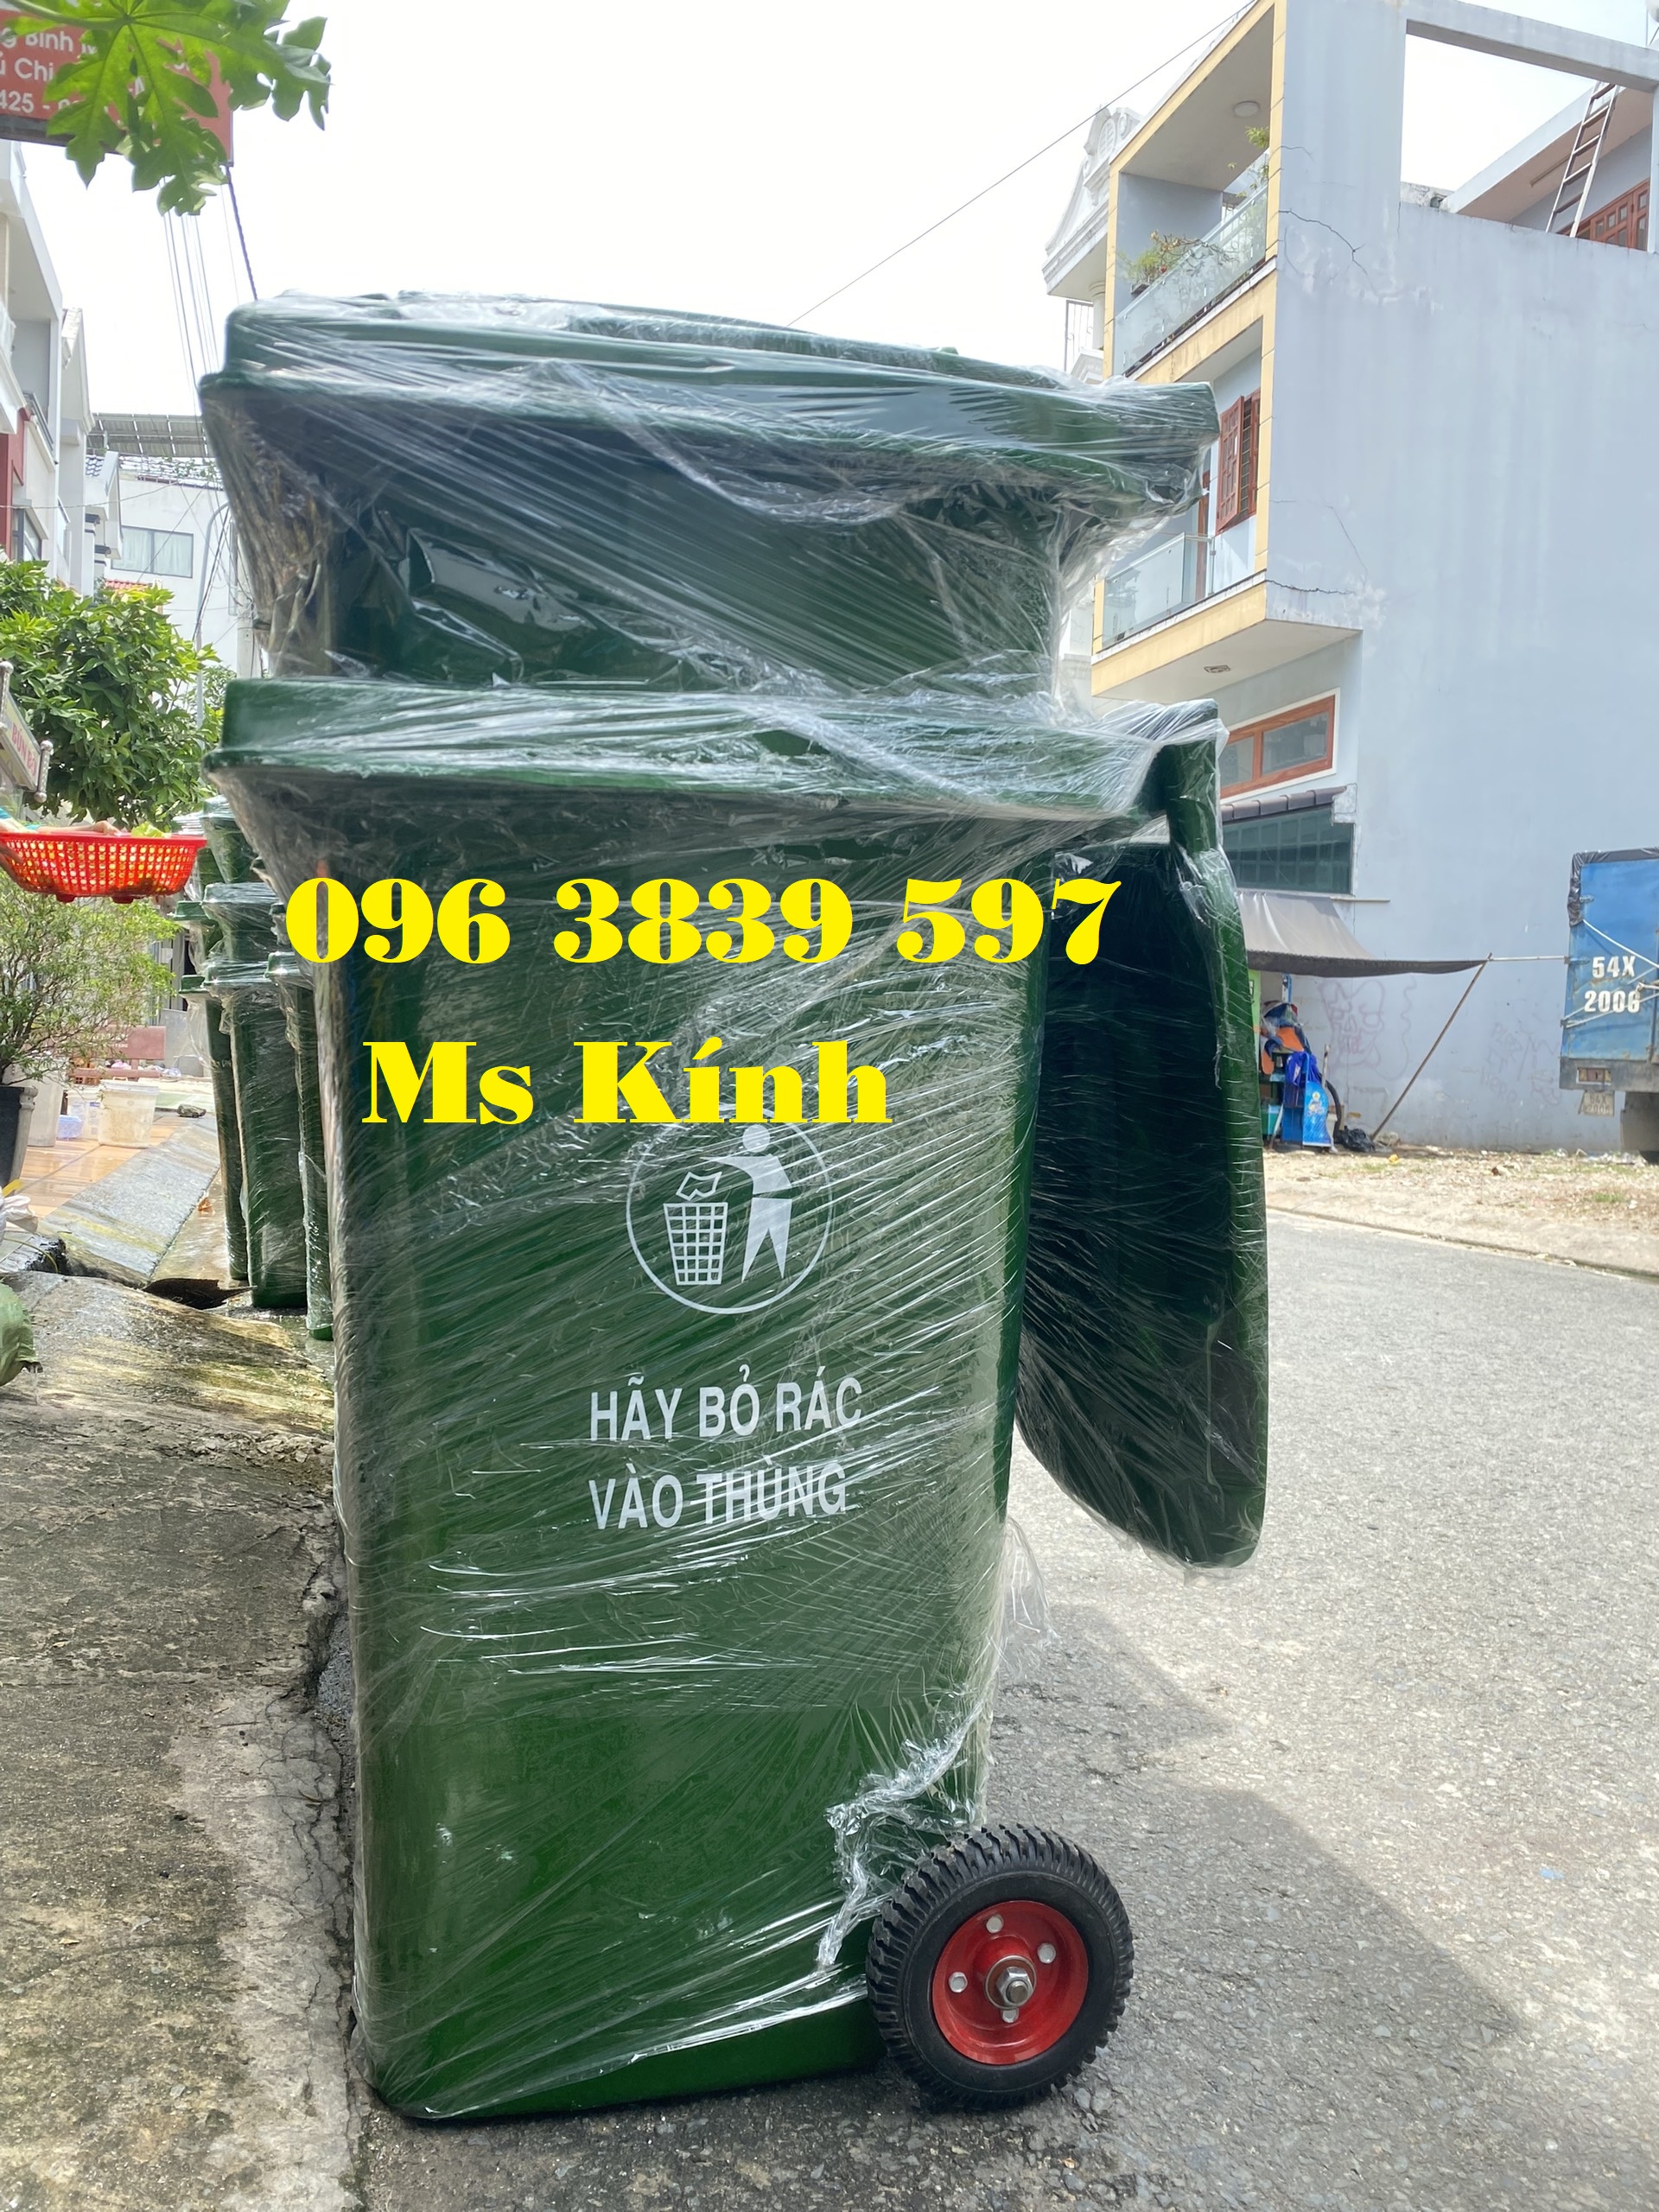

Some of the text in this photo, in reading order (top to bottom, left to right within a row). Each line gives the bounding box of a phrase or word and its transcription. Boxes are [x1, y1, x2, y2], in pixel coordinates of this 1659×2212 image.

[1592, 956, 1636, 978] 54X
[1584, 990, 1640, 1014] 2006
[590, 1363, 862, 1441] HÃY BỎ RÁC
[588, 1454, 847, 1529] VÀO THÙNG
